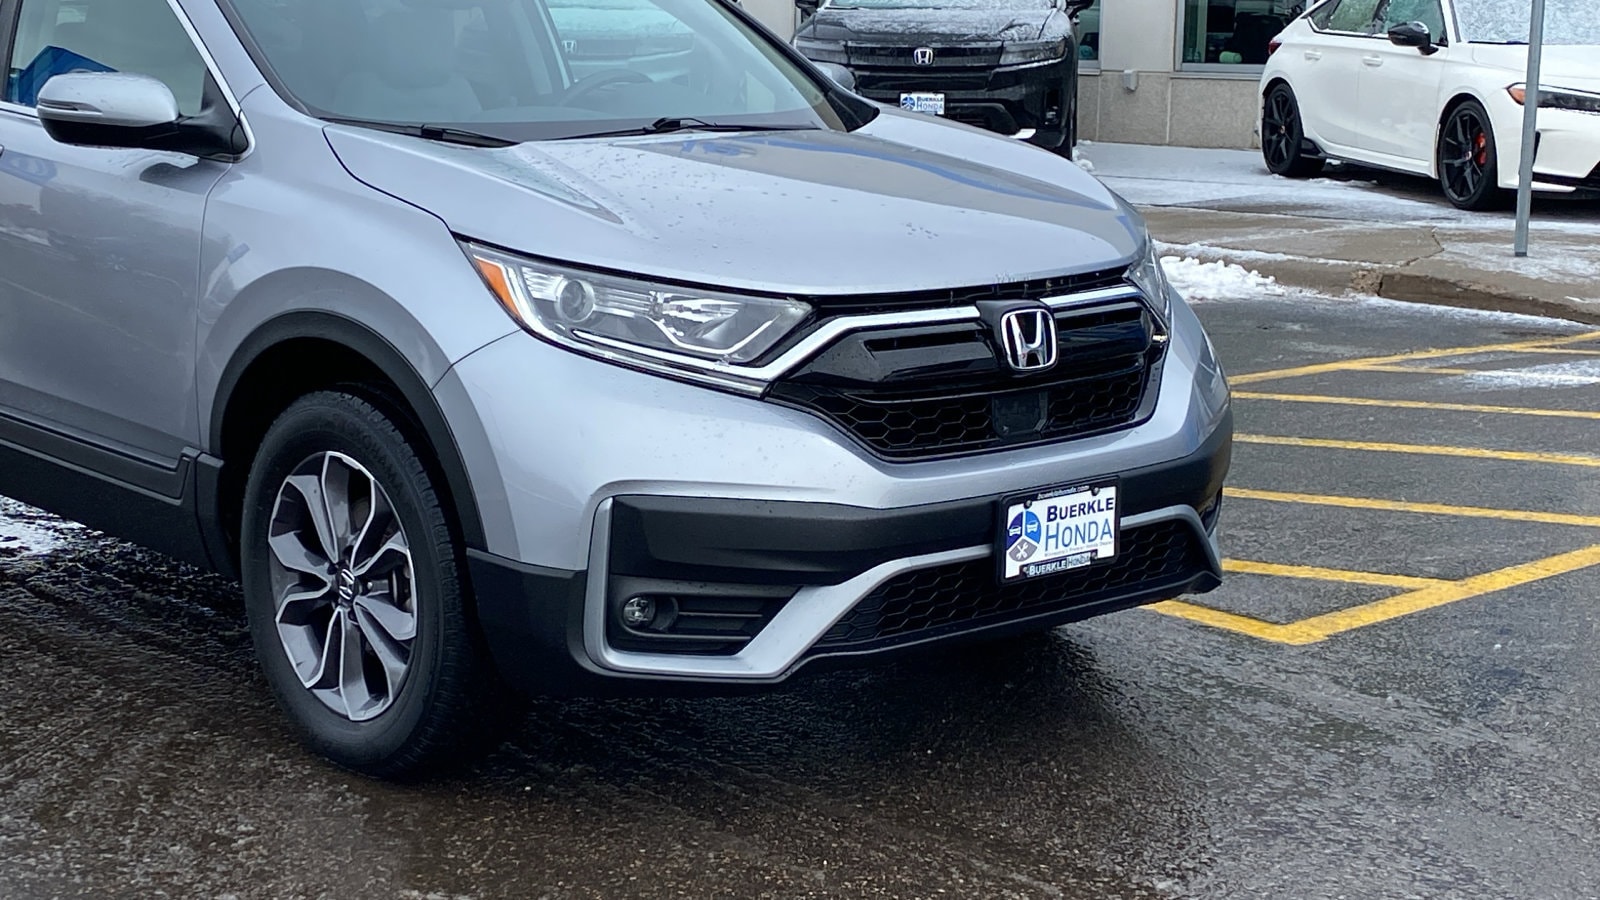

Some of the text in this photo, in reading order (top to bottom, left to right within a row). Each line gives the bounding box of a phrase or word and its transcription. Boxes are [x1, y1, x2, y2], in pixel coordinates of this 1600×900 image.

[917, 101, 943, 109] HONDA
[1046, 497, 1115, 522] BUERKLE
[1044, 518, 1113, 552] HONDA
[1029, 560, 1067, 576] BUERKLE
